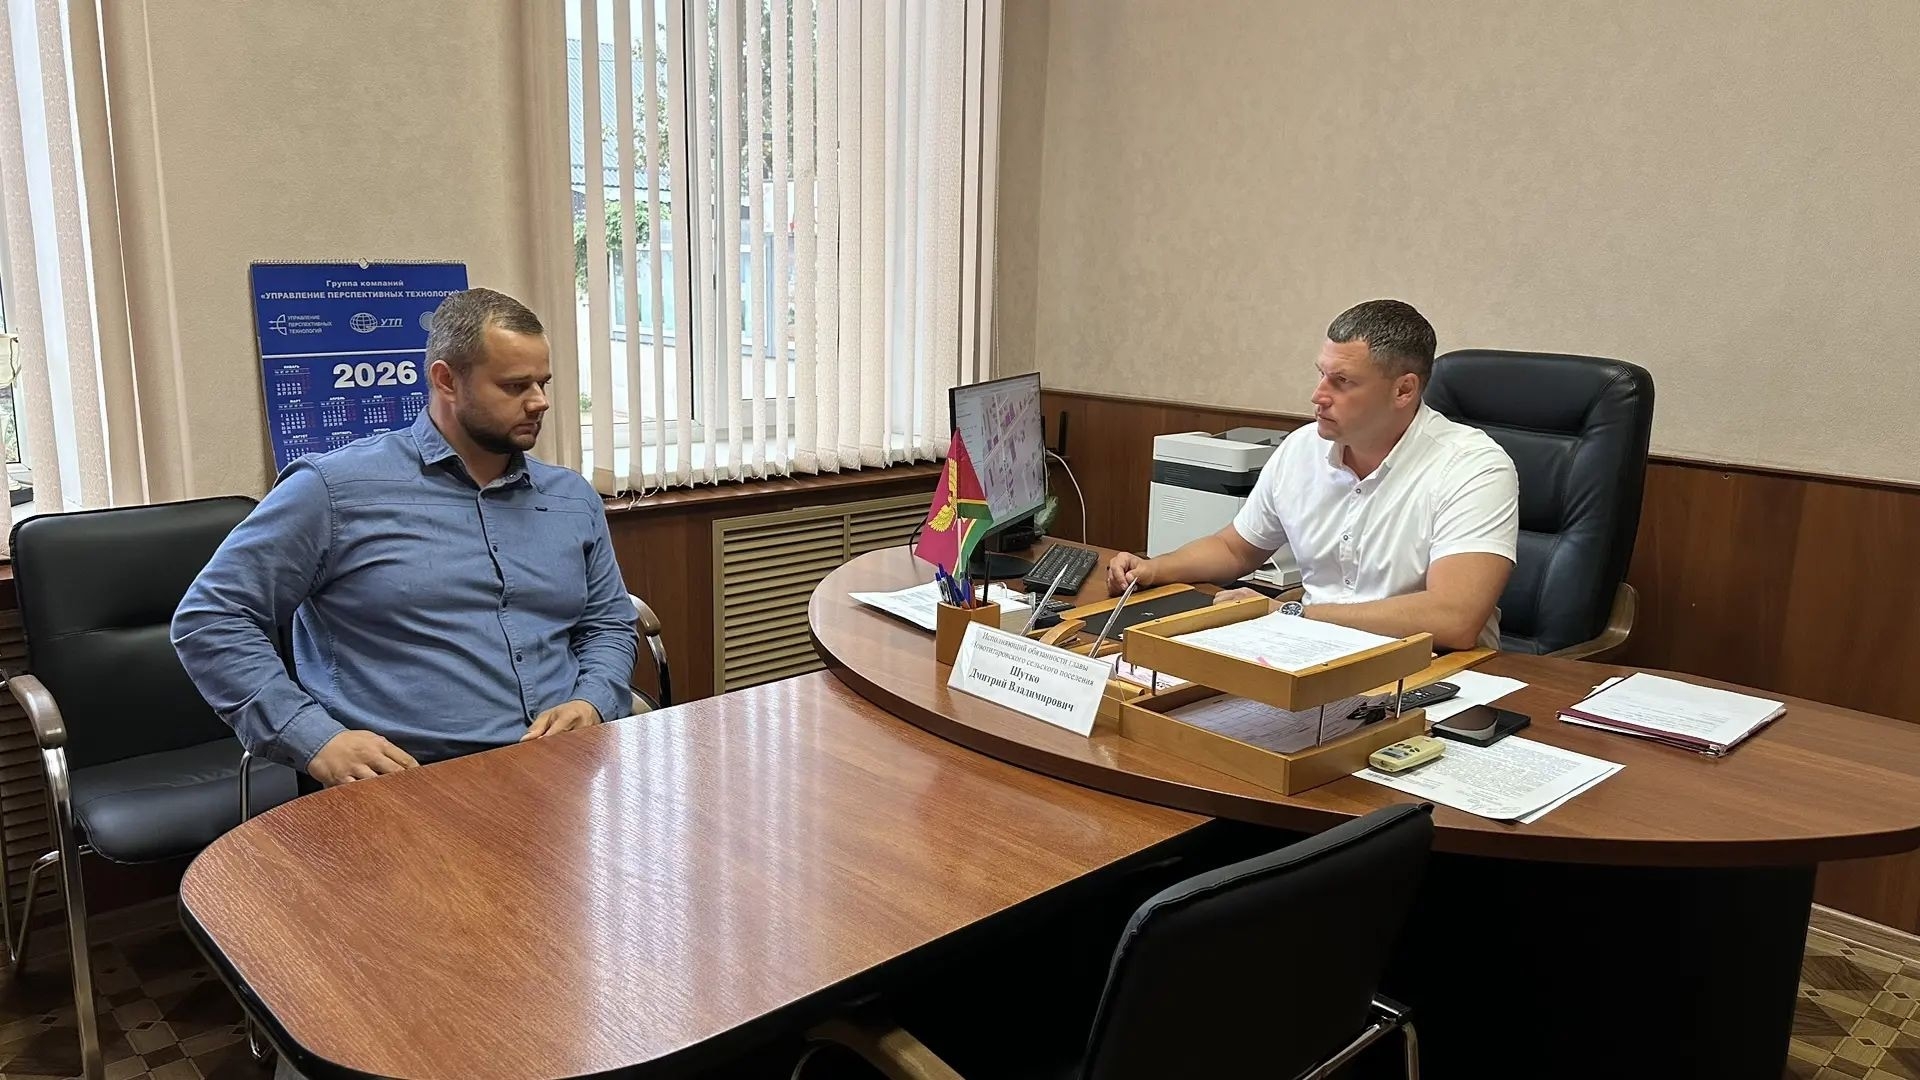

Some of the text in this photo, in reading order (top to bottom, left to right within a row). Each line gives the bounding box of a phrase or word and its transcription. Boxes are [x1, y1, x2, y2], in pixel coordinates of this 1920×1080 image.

[261, 291, 326, 299] «УПРАВЛЕНИЕ
[327, 290, 404, 298] ПЕРСПЕКТИВНЫХ
[325, 280, 357, 288] Группа
[380, 318, 402, 327] УТП
[333, 361, 418, 389] 2026
[982, 631, 1089, 672] Исполняющий обязанности главы
[1009, 665, 1040, 684] Шутко
[1026, 659, 1059, 675] сельского
[1059, 670, 1094, 686] поселения
[969, 667, 1074, 712] Дмитрий Владимирович
